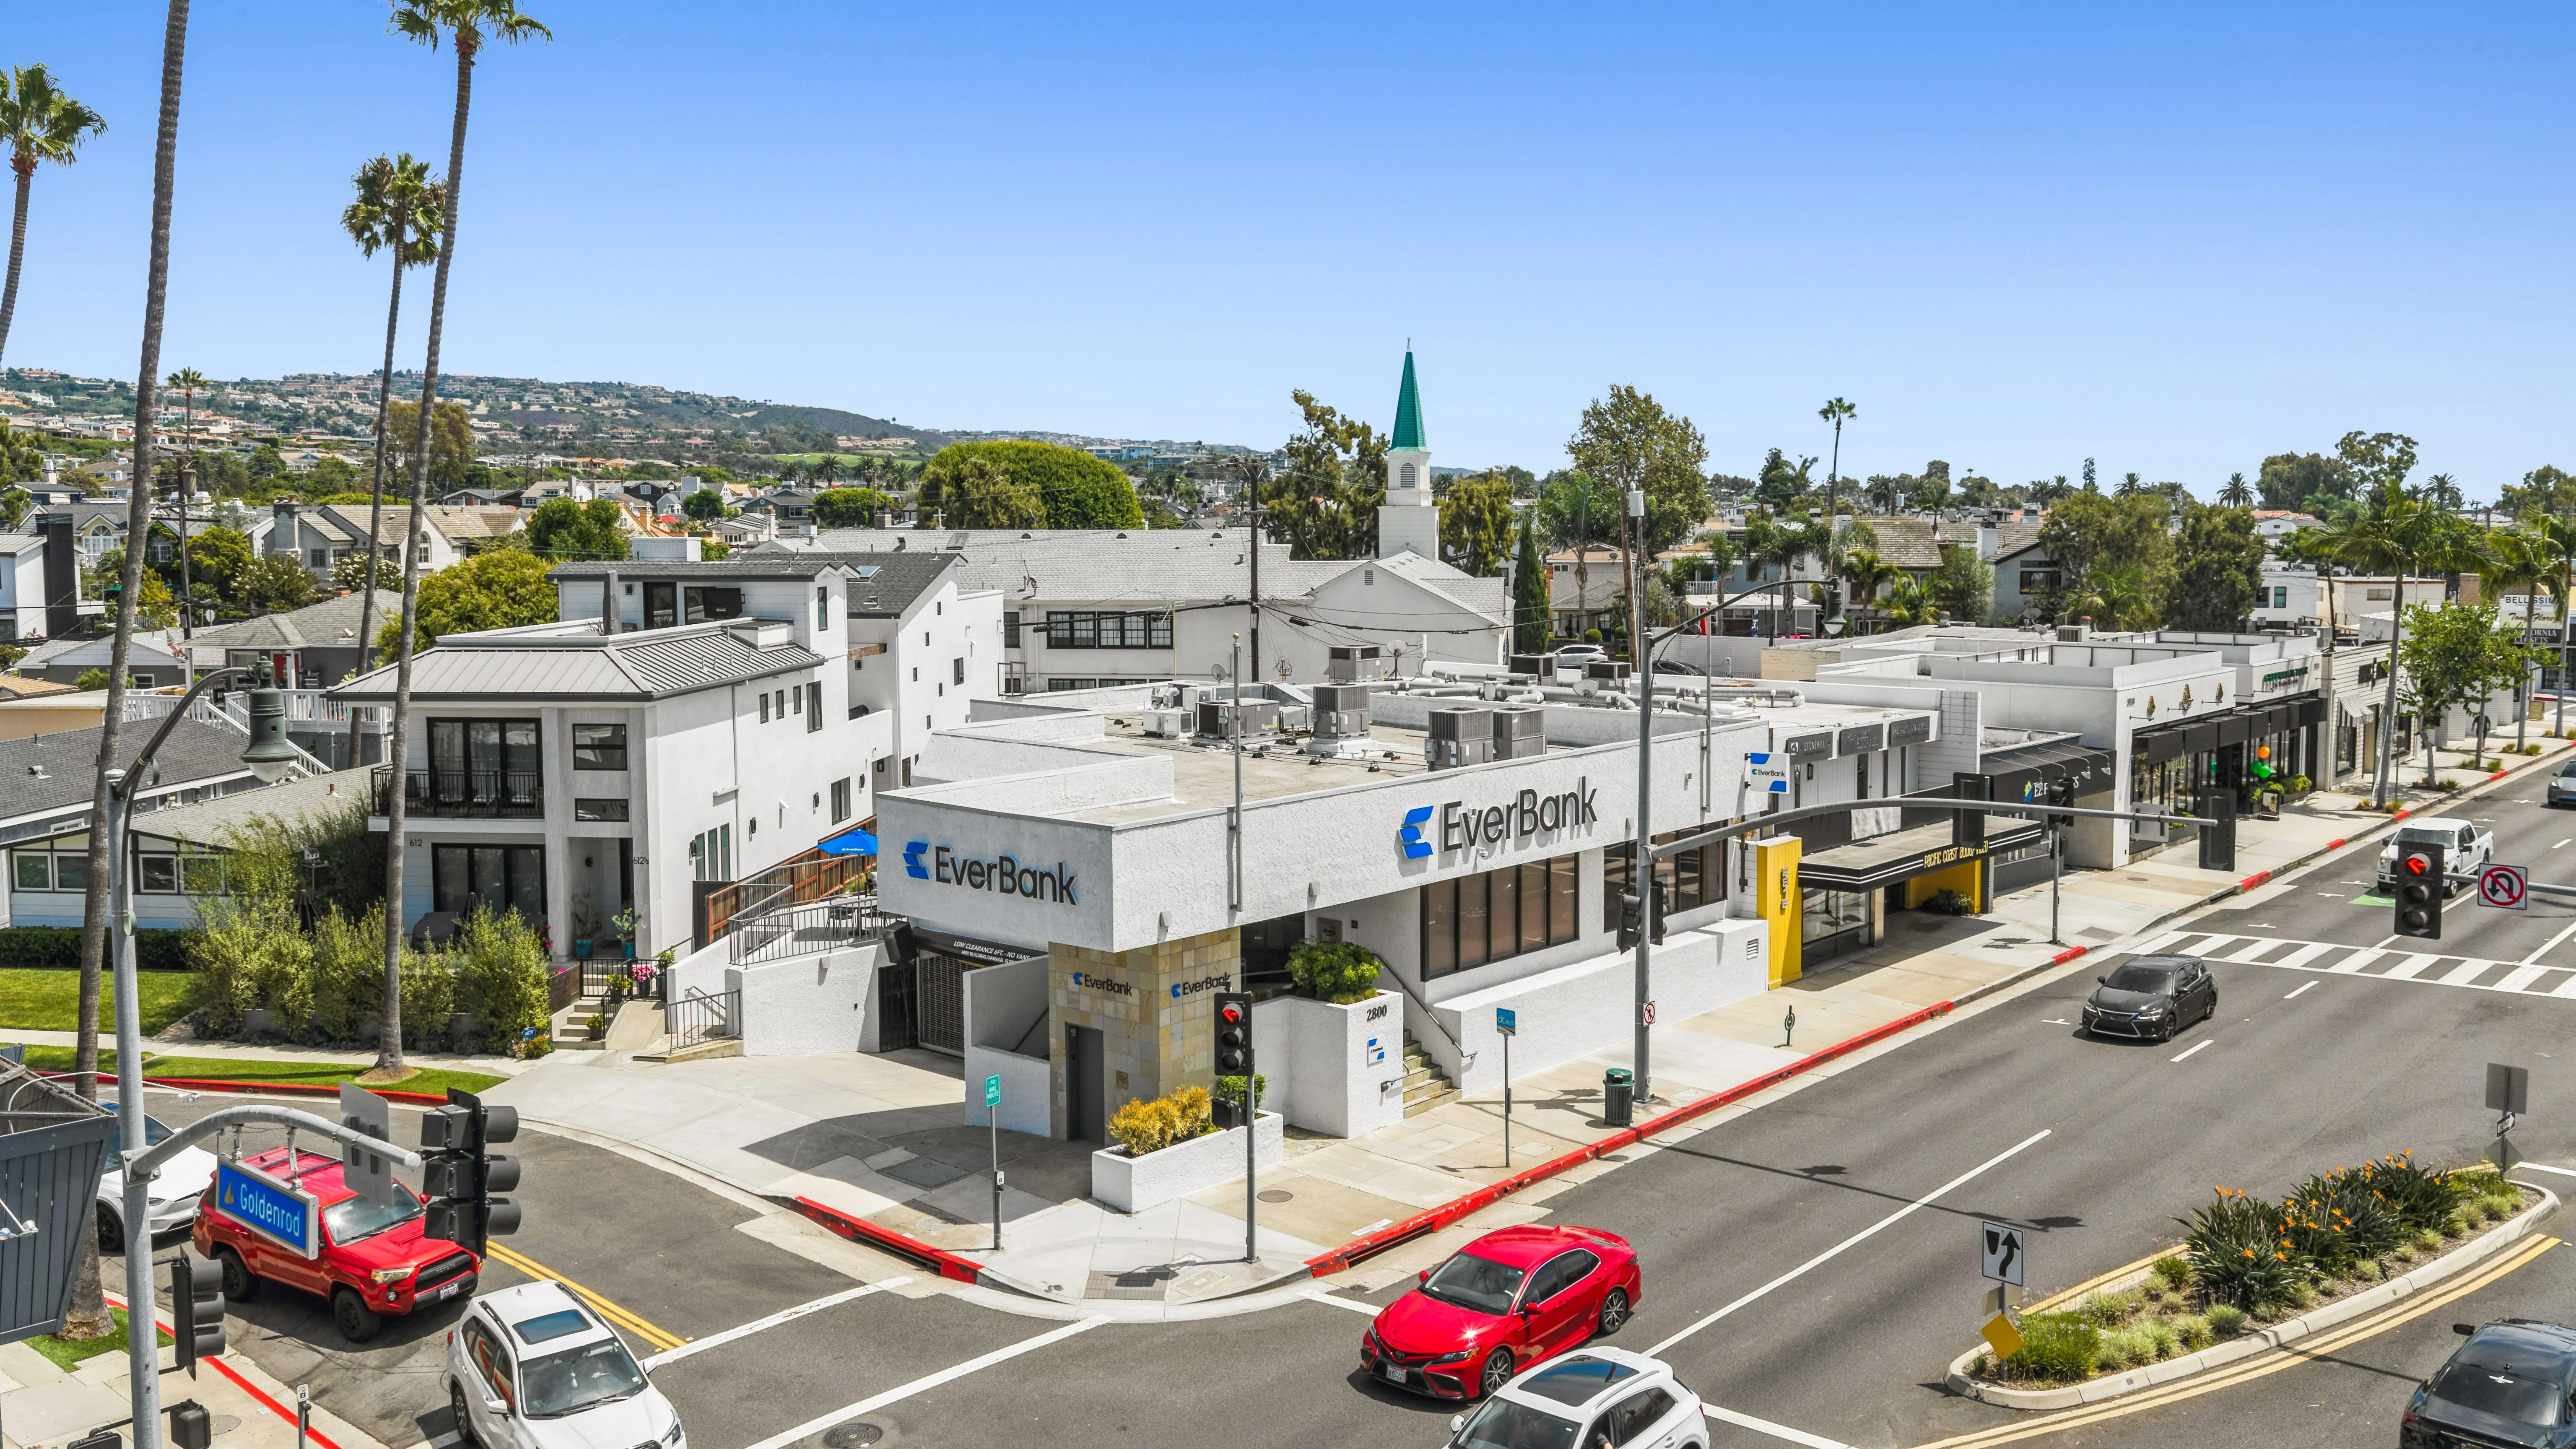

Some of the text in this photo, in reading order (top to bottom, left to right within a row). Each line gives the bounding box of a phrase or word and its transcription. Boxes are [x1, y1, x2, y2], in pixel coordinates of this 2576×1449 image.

[1804, 740, 1825, 751] STONEHILL
[1441, 776, 1598, 852] EverBank
[935, 846, 1078, 905] EverBank
[966, 943, 994, 954] CLEARANCE
[1084, 975, 1132, 996] EverBank
[1183, 972, 1231, 995] EverBank
[1367, 1005, 1387, 1021] 2800
[987, 1090, 1000, 1099] ROUTE
[241, 1183, 300, 1237] Goldenrod
[436, 1263, 456, 1274] TOYOTA
